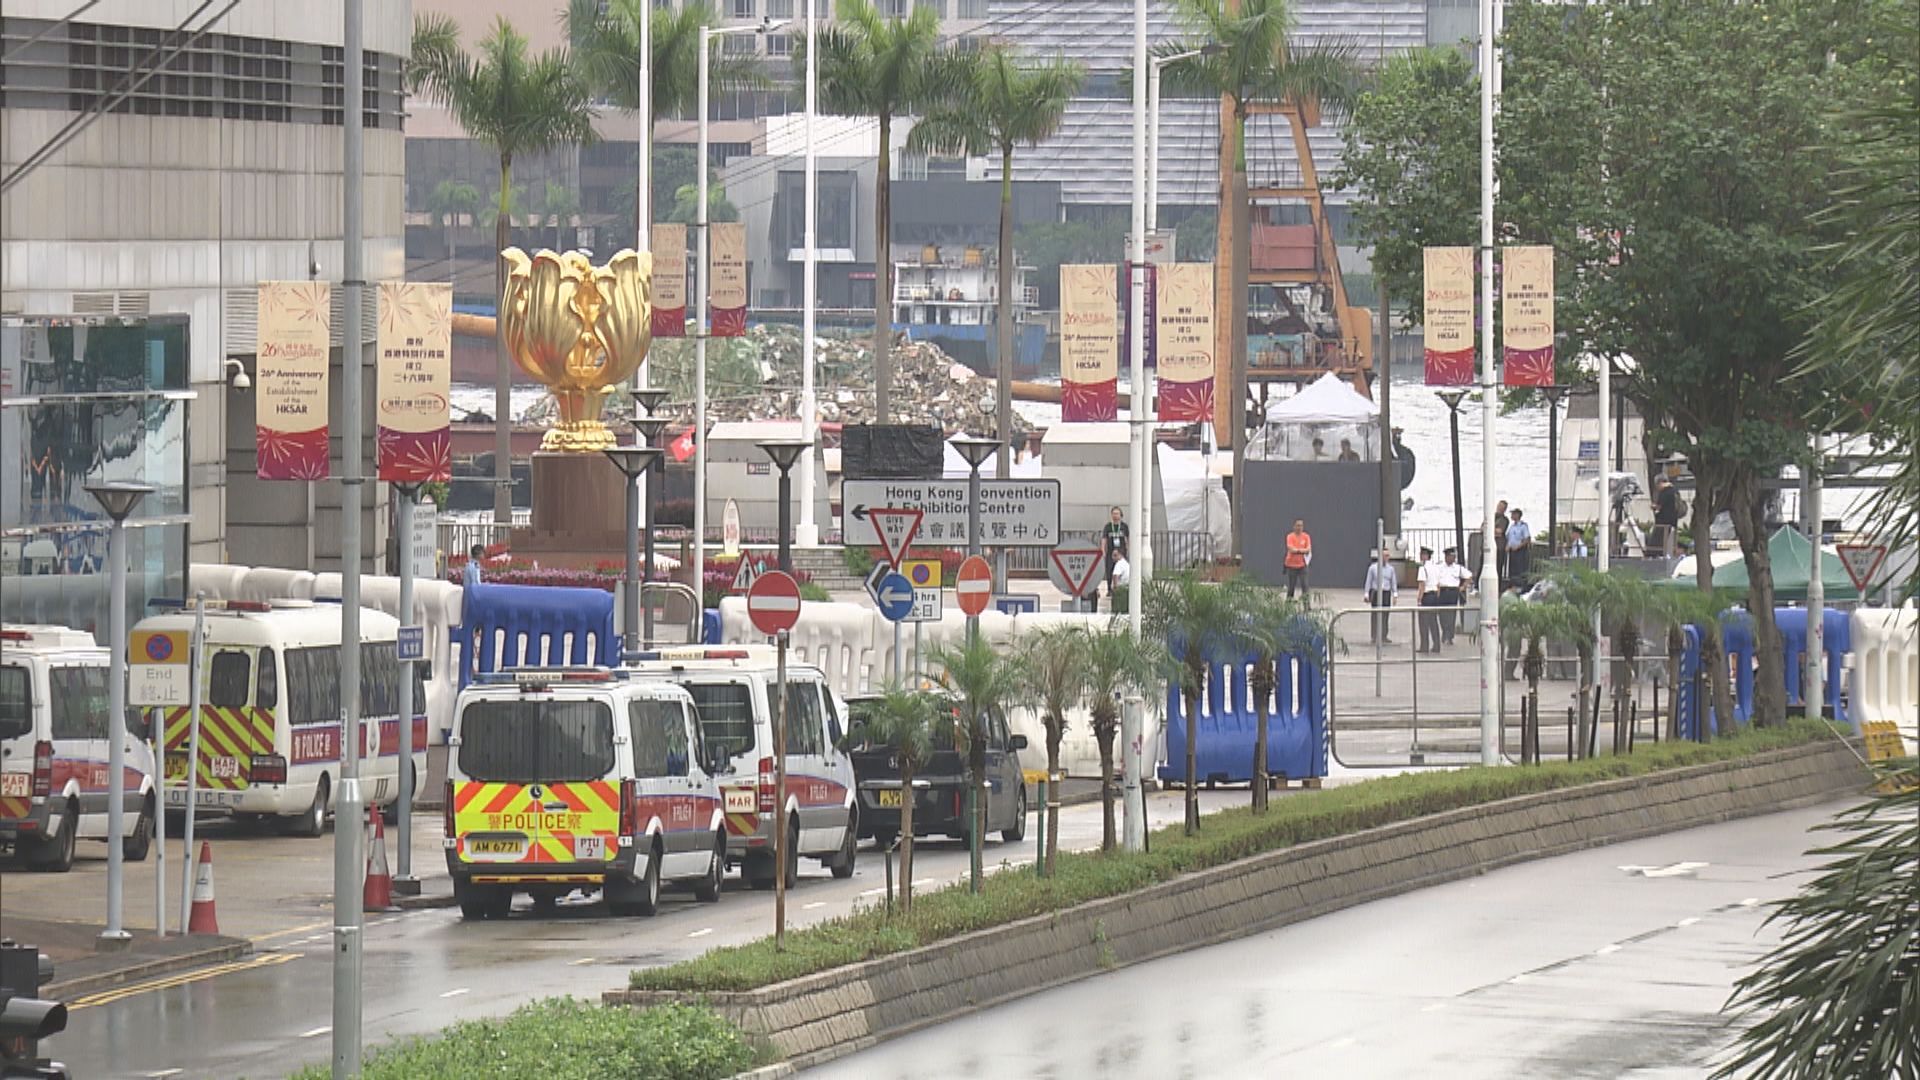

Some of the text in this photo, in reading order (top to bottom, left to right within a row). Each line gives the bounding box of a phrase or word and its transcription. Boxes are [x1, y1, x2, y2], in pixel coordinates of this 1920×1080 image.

[1076, 361, 1101, 369] HKSAR
[277, 368, 324, 380] Anniversary
[266, 385, 318, 396] Establishment
[276, 404, 308, 415] HKSAR
[886, 486, 1051, 500] Hong Kong onvention
[979, 502, 1025, 514] Centre
[887, 525, 904, 533] WAY
[921, 592, 936, 601] hrs
[146, 668, 172, 679] End
[728, 797, 752, 807] MAR
[503, 814, 566, 829] POLICE
[474, 841, 519, 852] AM 6771
[580, 837, 600, 848] PTU
[586, 848, 594, 857] 2
